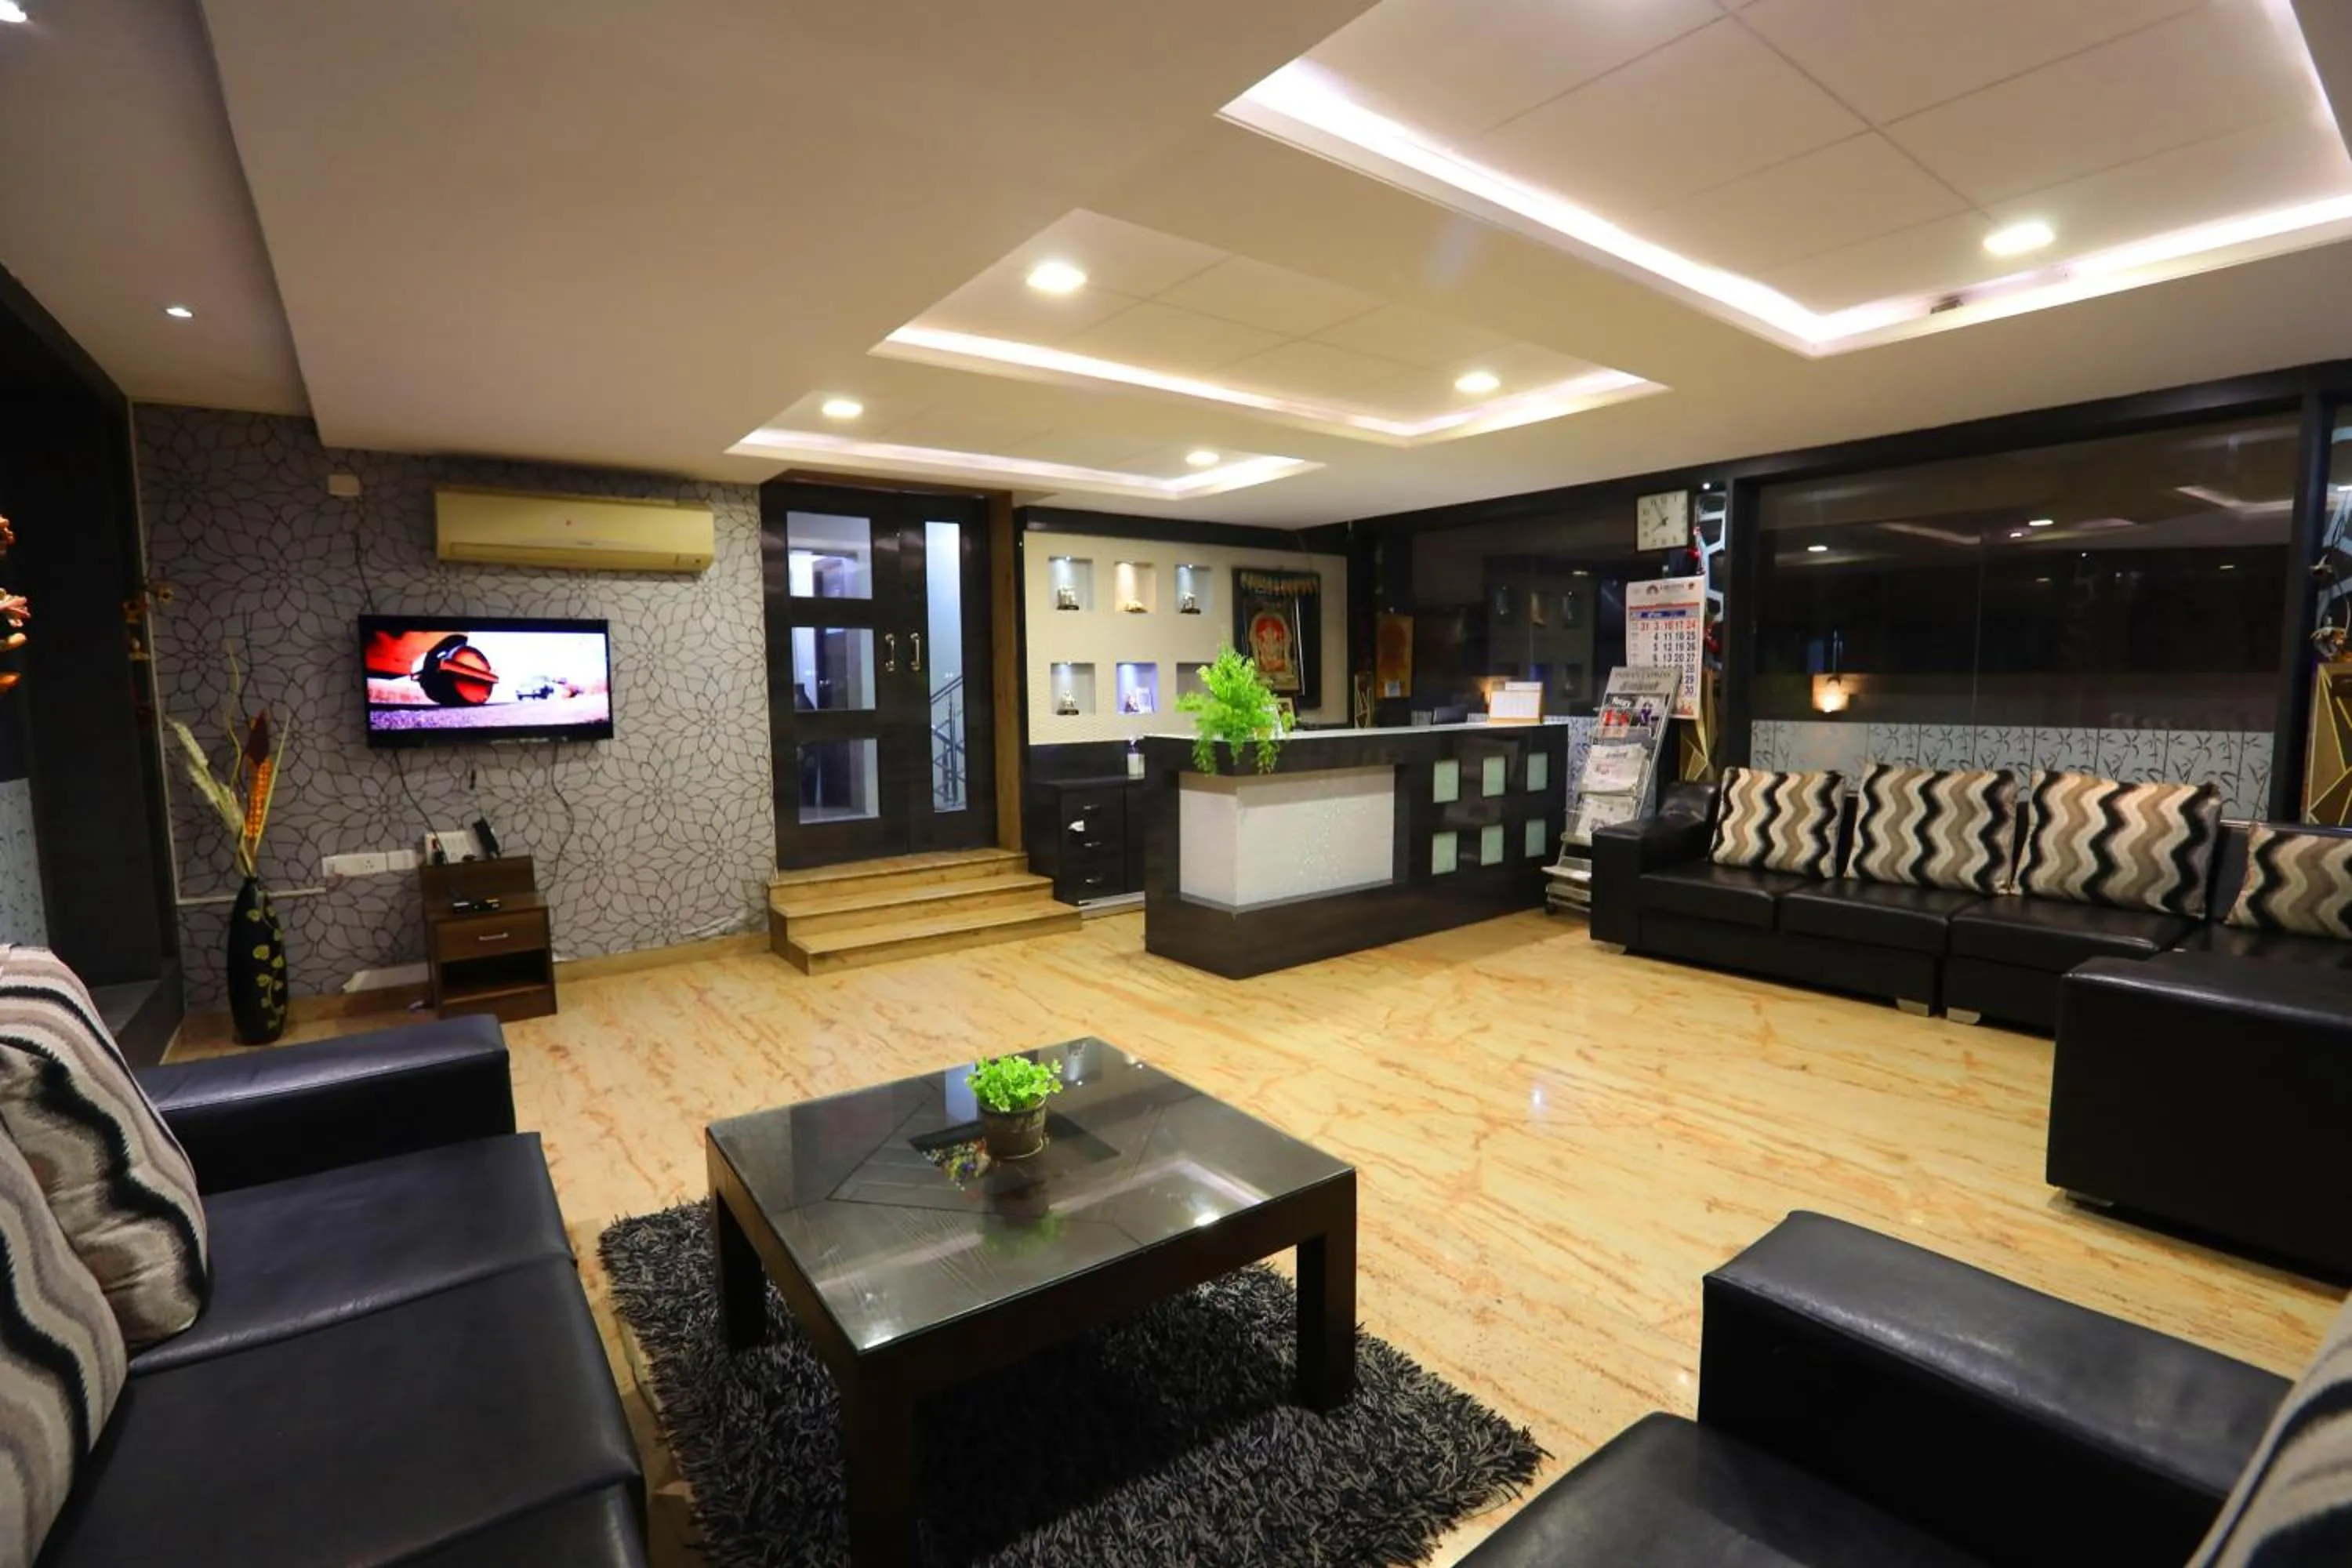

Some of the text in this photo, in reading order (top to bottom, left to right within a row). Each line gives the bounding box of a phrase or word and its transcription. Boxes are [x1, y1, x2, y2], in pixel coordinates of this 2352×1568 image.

[1654, 621, 1660, 631] 3
[1664, 621, 1672, 630] 10
[1686, 619, 1696, 630] 24
[1686, 631, 1696, 641] 25
[1653, 643, 1658, 652] 5
[1663, 643, 1672, 652] 12
[1686, 642, 1696, 652] 26
[1663, 653, 1672, 662] 13
[1674, 653, 1685, 662] 20
[1686, 652, 1696, 662] 27
[1685, 675, 1694, 684] 29
[1685, 685, 1694, 696] 30
